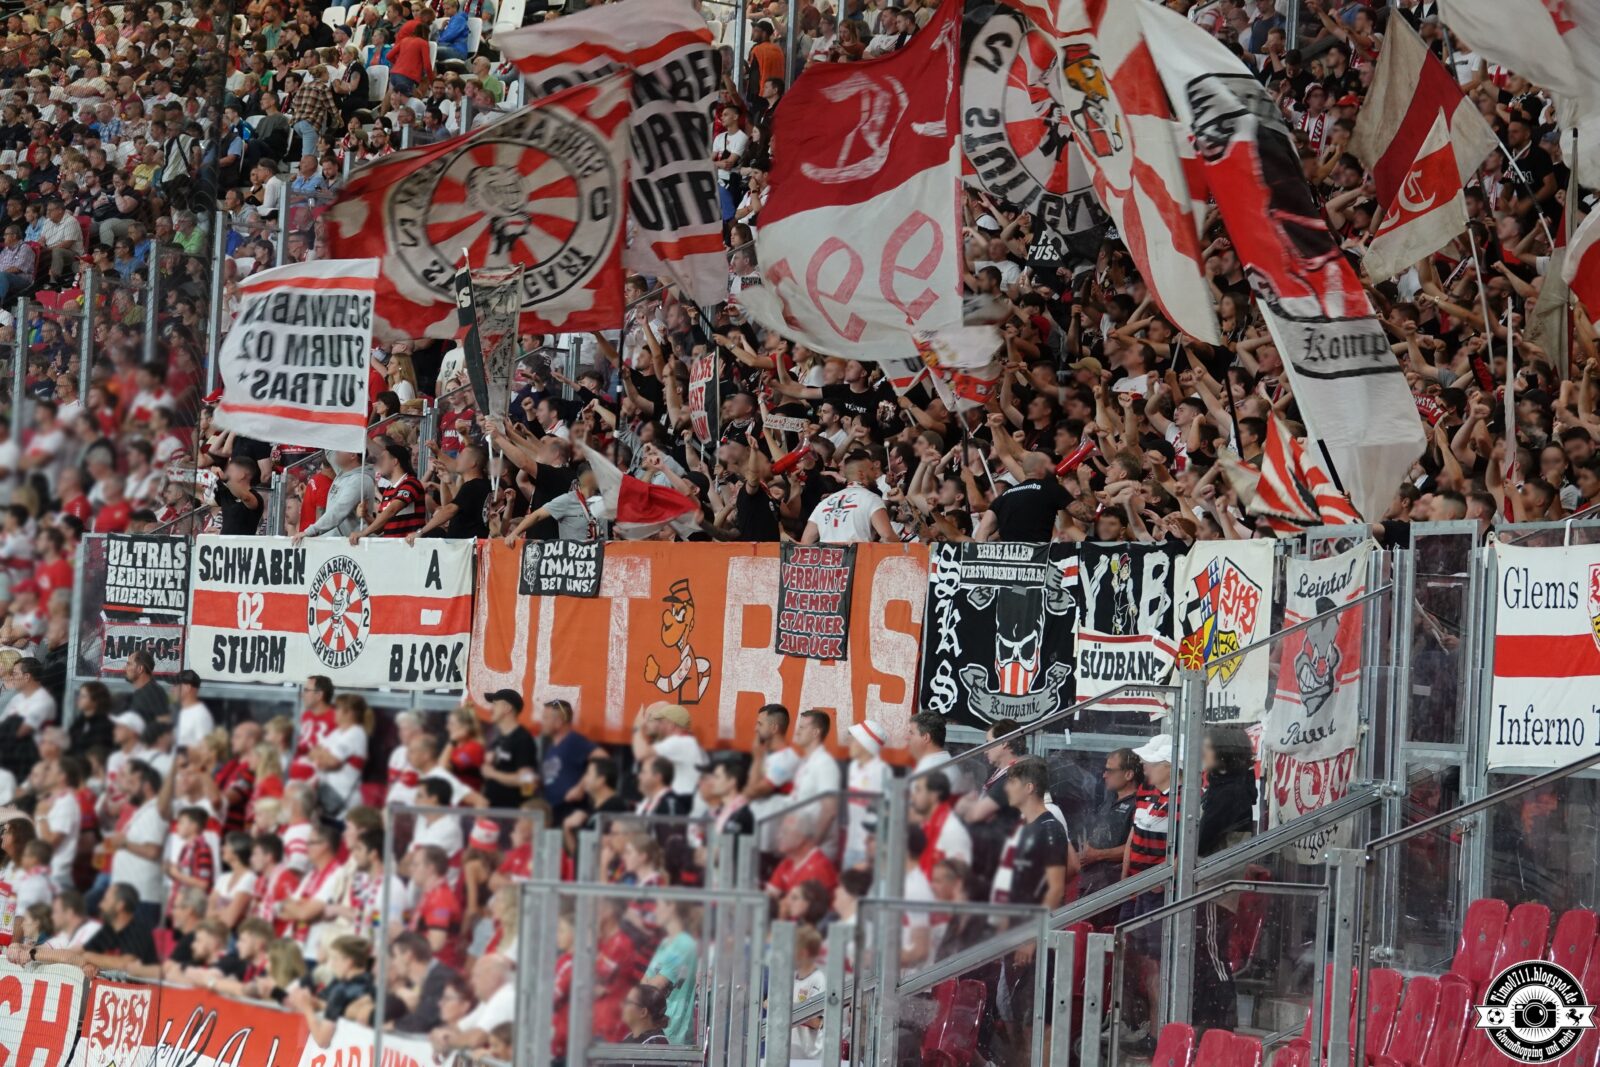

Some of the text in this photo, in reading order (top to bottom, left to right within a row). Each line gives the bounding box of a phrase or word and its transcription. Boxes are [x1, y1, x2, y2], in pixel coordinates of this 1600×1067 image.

[108, 539, 187, 569] ULTRAS
[543, 541, 598, 559] DU BIST
[790, 546, 844, 567] JEDER
[977, 543, 1034, 561] EHRE ALLEN
[106, 564, 186, 590] BEDEUTET
[199, 545, 307, 586] SCHWABEN
[309, 557, 370, 601] SCHWABENSTURM
[425, 549, 443, 590] A
[540, 558, 597, 578] IMMER
[782, 562, 850, 592] VERBANNTE
[962, 565, 1045, 583] VERSTORBENEN ULTRAS
[1294, 558, 1356, 598] Leintal
[106, 585, 185, 609] WIDERSTAND
[540, 577, 596, 593] BEI UNS!
[1503, 566, 1579, 610] Glems
[237, 591, 265, 631] 02
[785, 590, 840, 613] KEHRT
[211, 634, 287, 674] STURM
[313, 636, 364, 668] STUTTGART
[388, 641, 464, 683] BLOCK
[1496, 703, 1585, 746] Inferno
